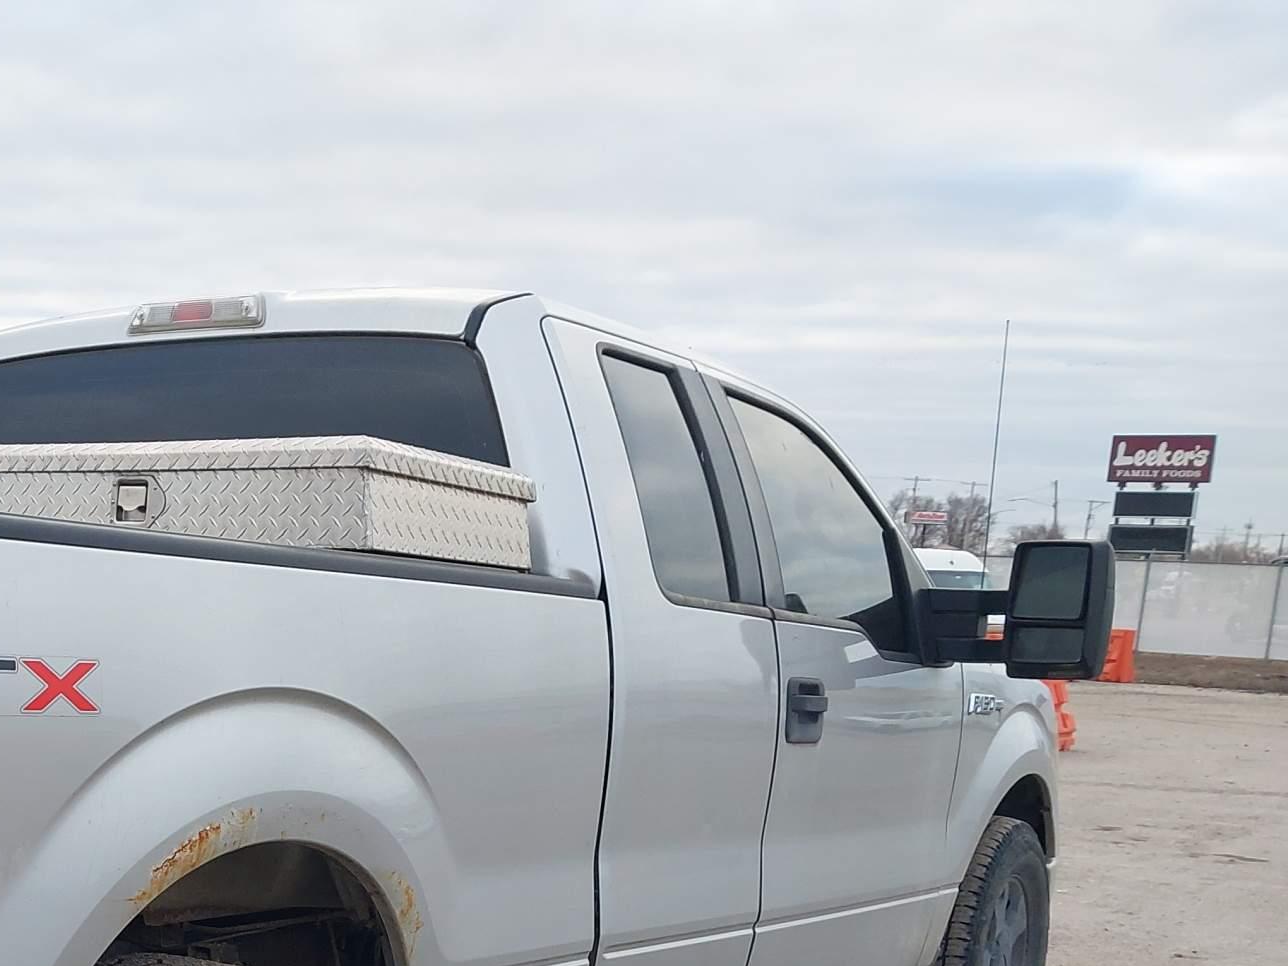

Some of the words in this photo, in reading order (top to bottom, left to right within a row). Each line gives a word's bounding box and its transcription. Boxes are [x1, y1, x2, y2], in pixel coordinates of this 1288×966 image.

[1113, 441, 1210, 467] Leeker's
[1115, 469, 1160, 478] FAMILY
[1161, 469, 1202, 478] FOODS
